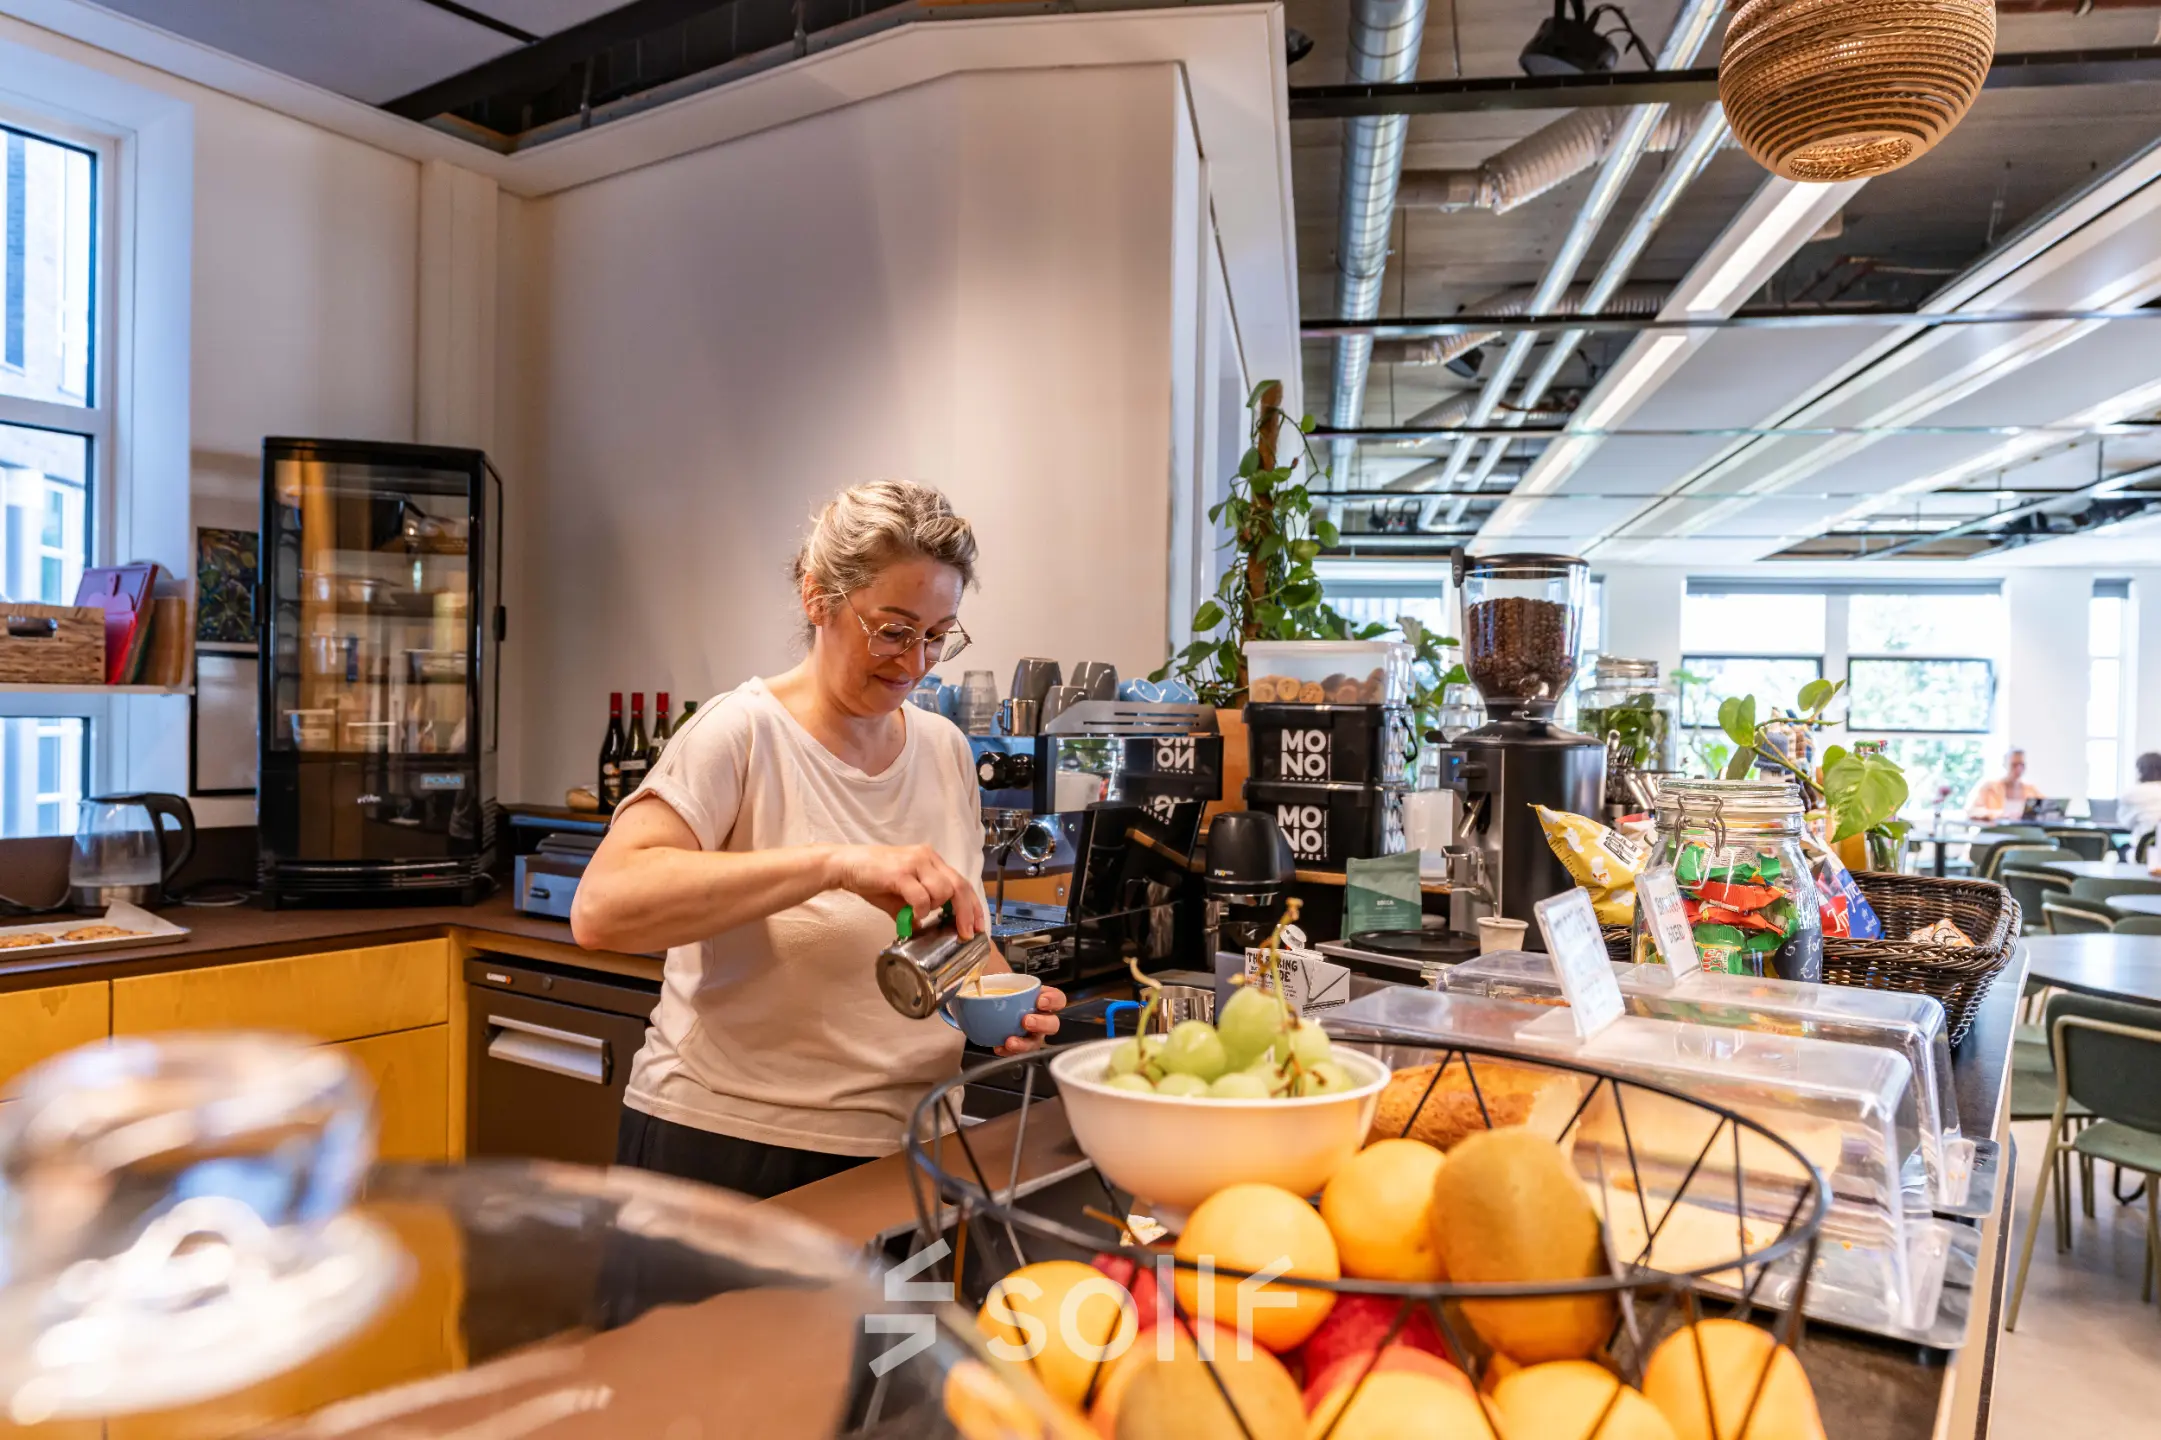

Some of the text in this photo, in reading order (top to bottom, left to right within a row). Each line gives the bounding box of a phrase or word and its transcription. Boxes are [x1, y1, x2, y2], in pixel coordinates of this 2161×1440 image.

[1281, 729, 1327, 752] MO
[1281, 752, 1326, 777] NO
[1278, 804, 1322, 828] MO
[1280, 828, 1322, 852] NO
